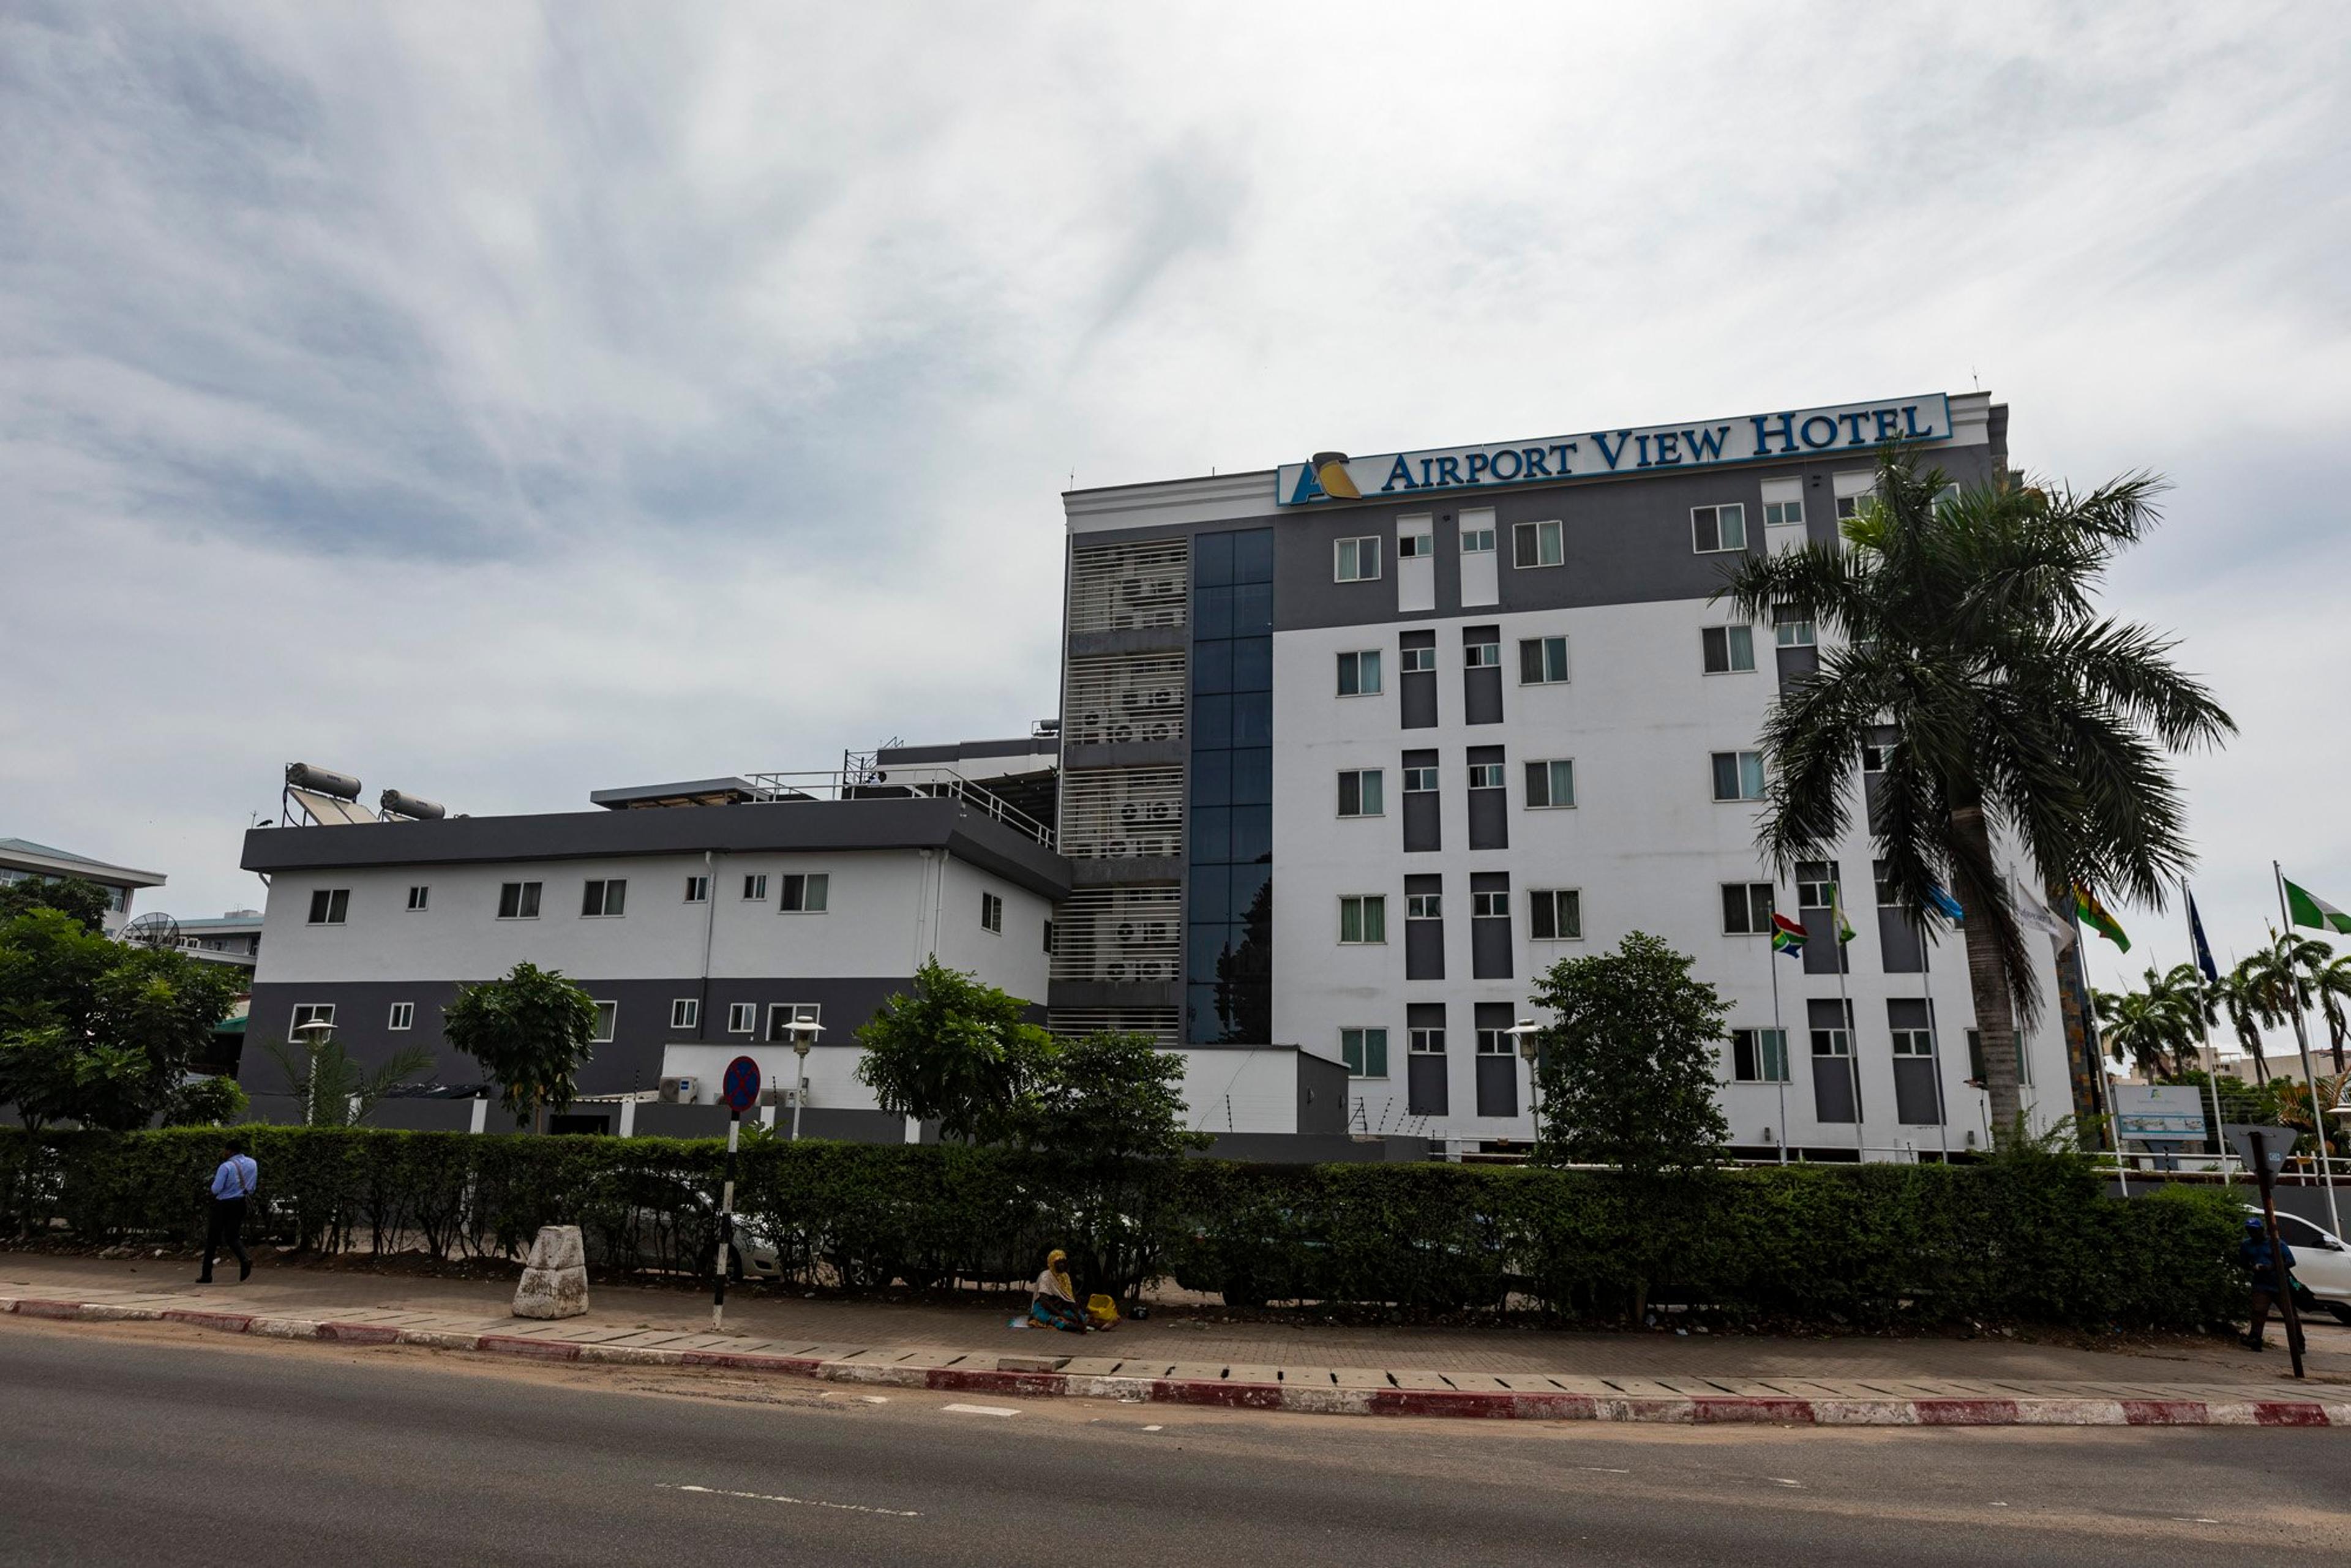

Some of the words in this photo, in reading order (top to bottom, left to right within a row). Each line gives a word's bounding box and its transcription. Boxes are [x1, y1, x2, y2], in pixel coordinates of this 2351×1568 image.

[1381, 443, 1577, 490] AIRPORT
[1591, 426, 1731, 470] VIEW
[1750, 405, 1933, 455] HOTEL
